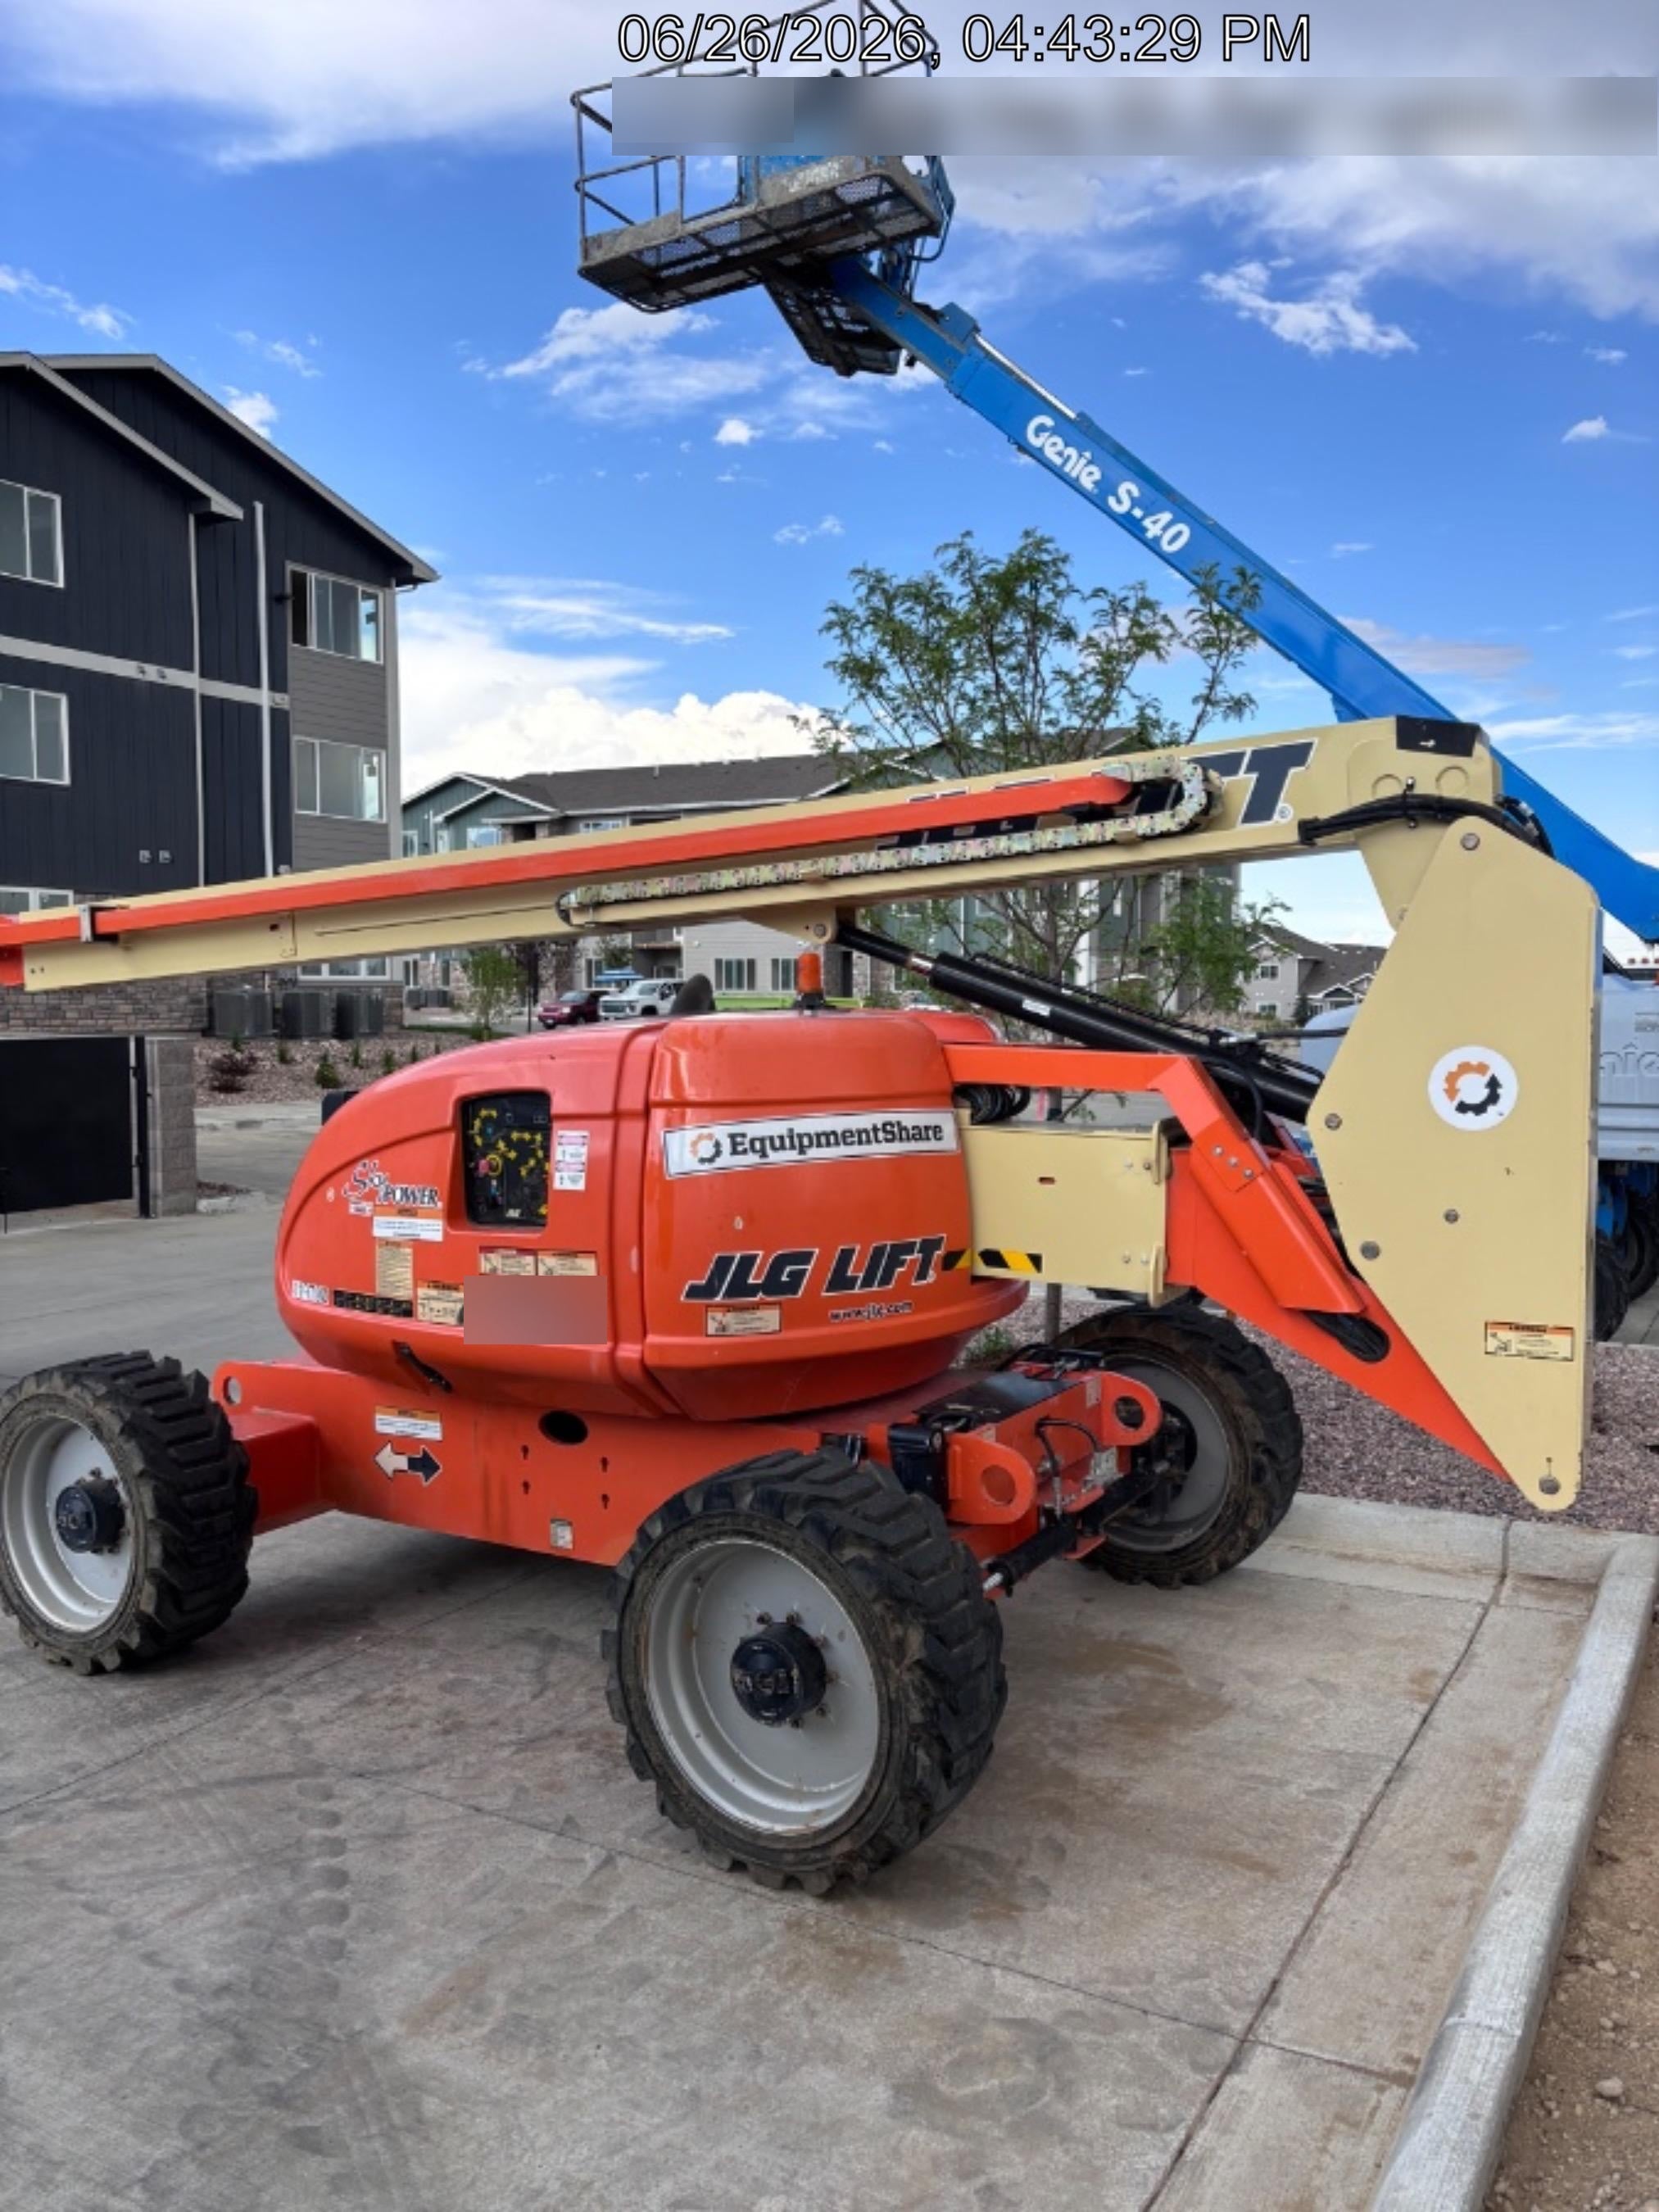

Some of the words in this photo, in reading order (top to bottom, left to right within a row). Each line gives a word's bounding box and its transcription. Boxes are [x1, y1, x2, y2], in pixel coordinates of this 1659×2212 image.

[1027, 415, 1101, 492] Genie
[1108, 481, 1190, 553] S-40
[728, 1121, 943, 1158] EquipmentShare
[681, 1249, 818, 1301] JLG
[822, 1234, 946, 1295] LIFT
